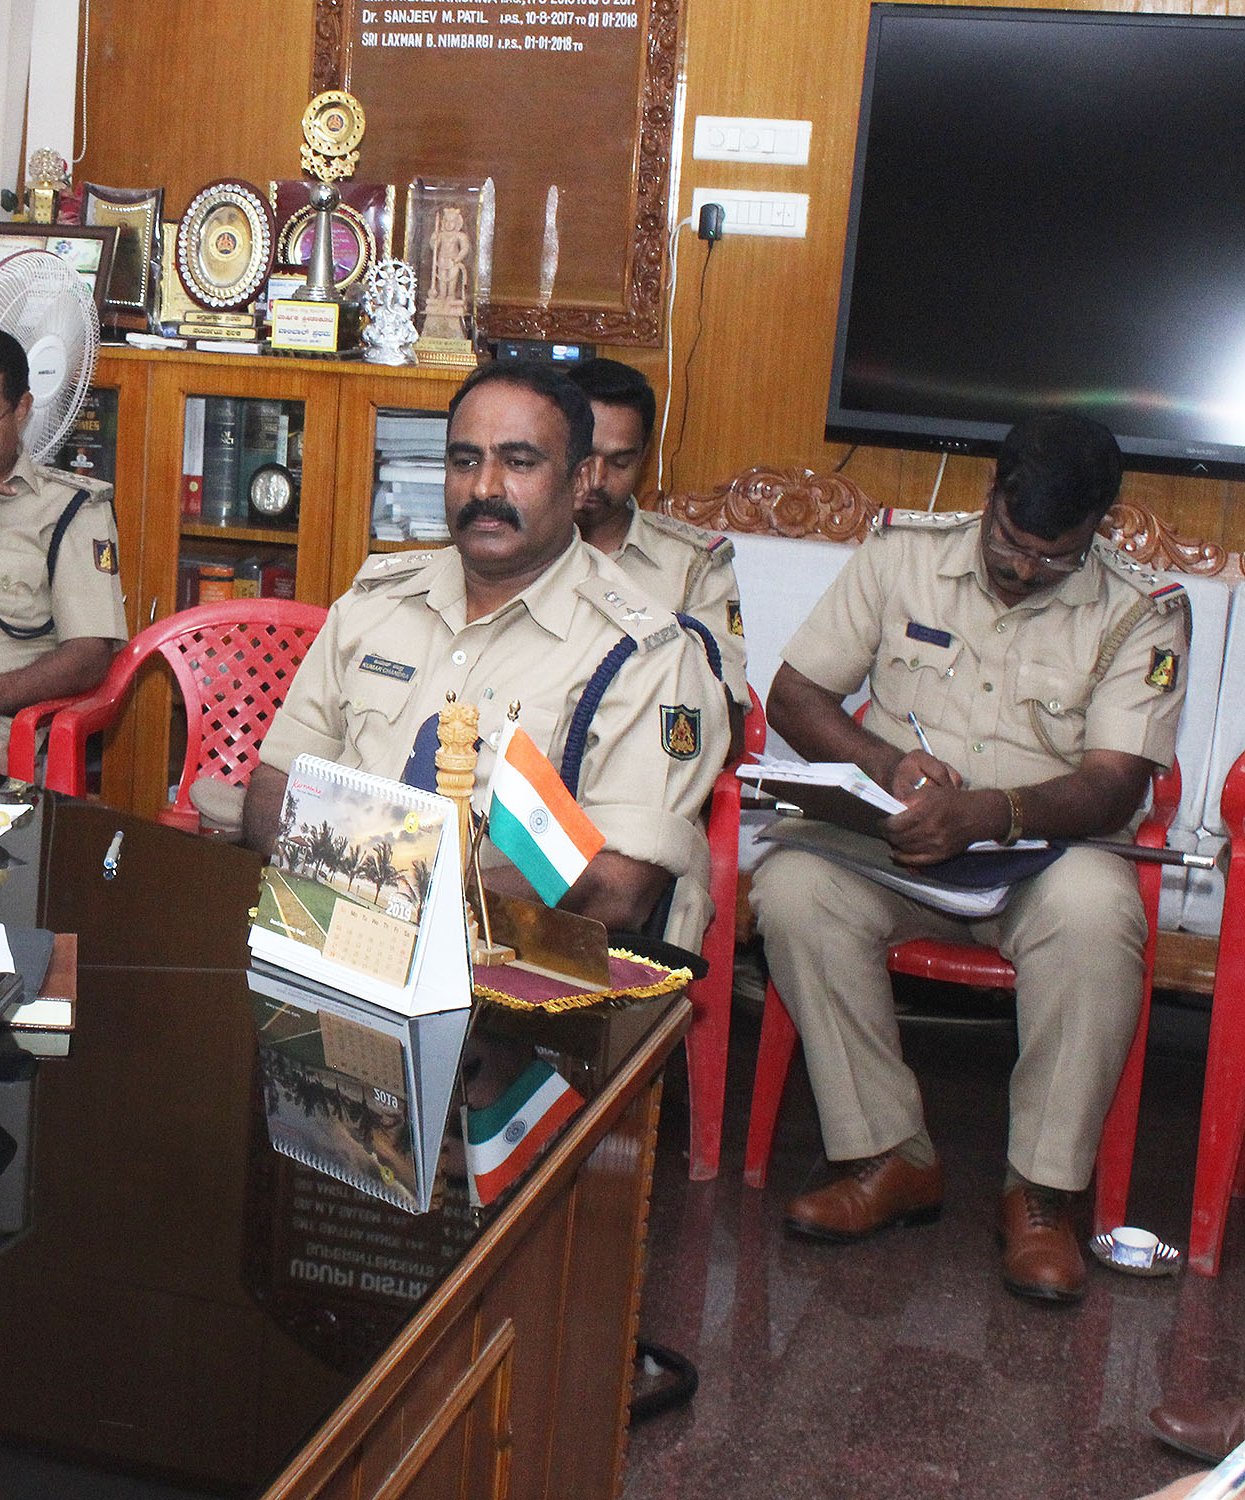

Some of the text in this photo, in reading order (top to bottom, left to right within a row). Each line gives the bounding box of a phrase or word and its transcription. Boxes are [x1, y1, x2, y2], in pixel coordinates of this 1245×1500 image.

[362, 9, 378, 24] Dr.
[384, 9, 437, 24] SANJEEV
[525, 11, 574, 25] 10-8-2017
[361, 32, 378, 47] SRI
[381, 32, 423, 47] LAXMAN
[524, 35, 572, 51] 01-01-2018
[385, 900, 412, 921] 2019
